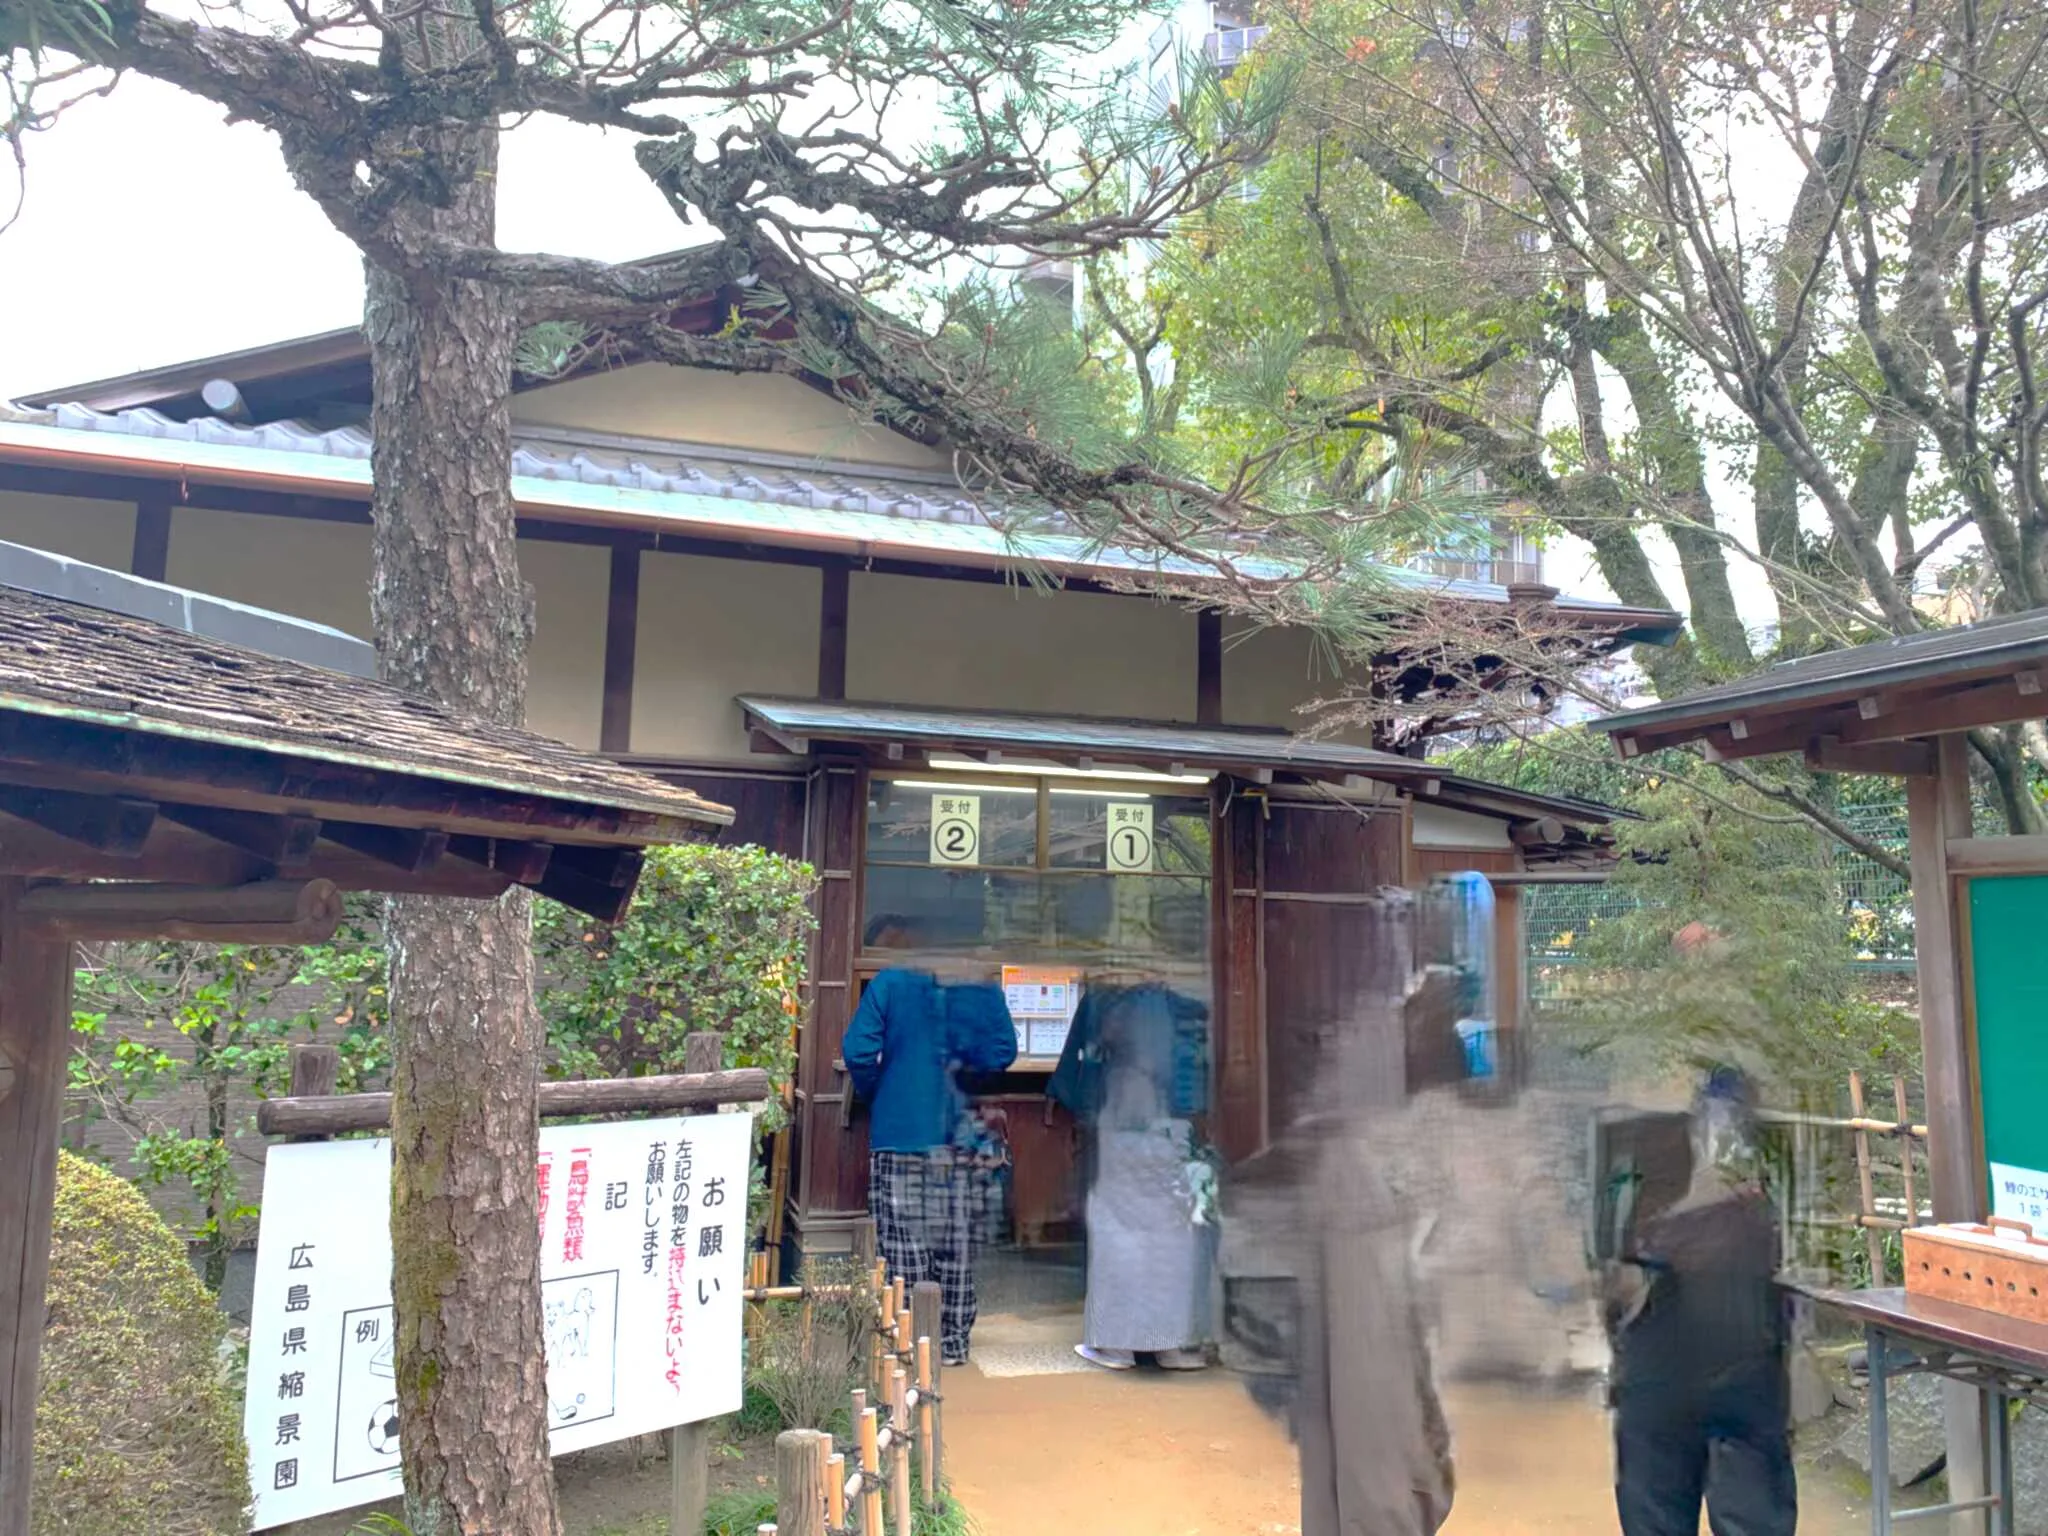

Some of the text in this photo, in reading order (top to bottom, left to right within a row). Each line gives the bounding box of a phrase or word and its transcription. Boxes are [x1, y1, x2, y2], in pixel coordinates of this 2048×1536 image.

[939, 799, 972, 814] 受付
[1115, 808, 1145, 823] 受付
[604, 1180, 629, 1211] 記
[697, 1176, 726, 1306] お願い
[355, 1317, 381, 1345] 例
[273, 1242, 316, 1491] 広島県縮景園
